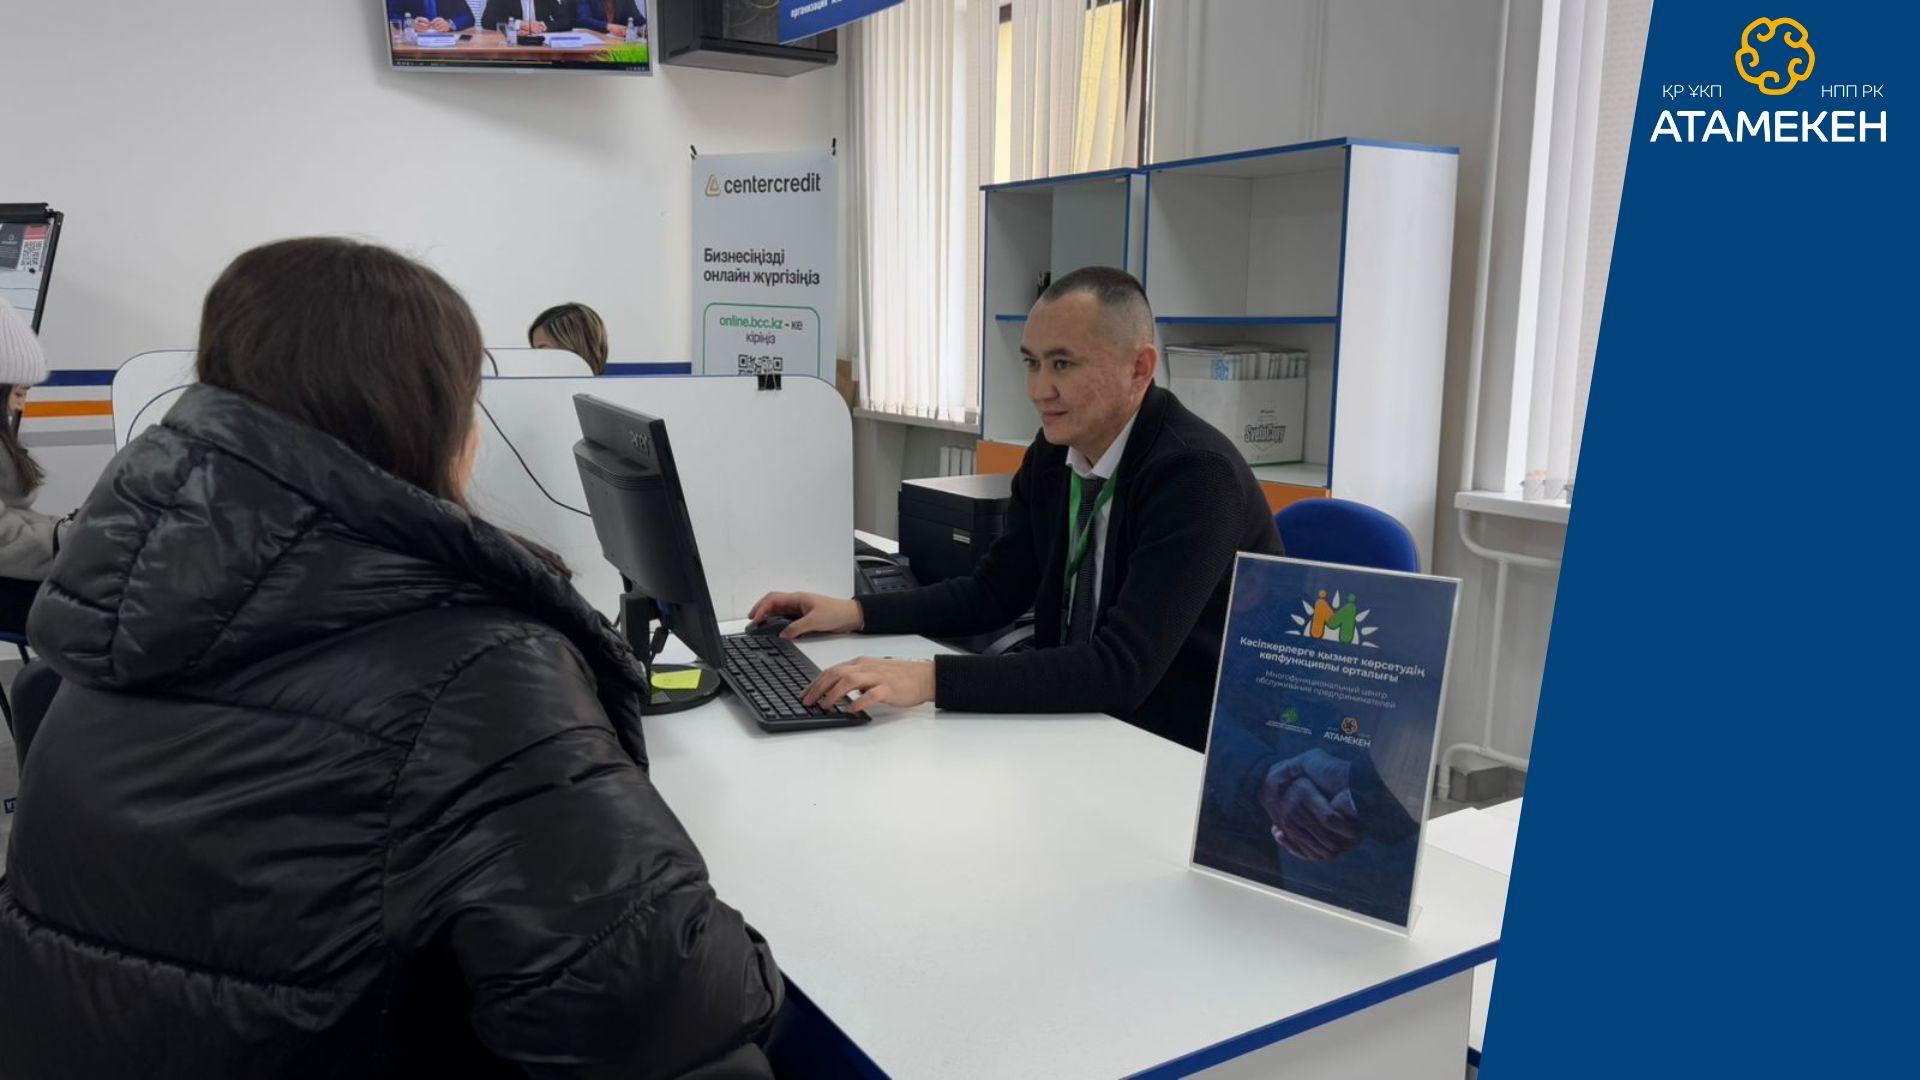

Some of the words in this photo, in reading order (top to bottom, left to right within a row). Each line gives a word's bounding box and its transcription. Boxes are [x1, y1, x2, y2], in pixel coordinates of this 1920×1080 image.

[724, 172, 821, 194] centercredit
[703, 247, 785, 267] Бизнесіңізді
[703, 267, 751, 283] онлайн
[752, 268, 821, 287] жүргізіңіз
[719, 315, 784, 330] online.bcc.kz
[1240, 636, 1316, 658] Кәсіпкерлерге
[1318, 651, 1359, 666] қызмет
[1361, 658, 1426, 678] көрсетудің
[1259, 651, 1340, 673] көпфункциялы
[1342, 665, 1399, 683] орталығы
[1322, 731, 1372, 748] АТАМЕКЕН
